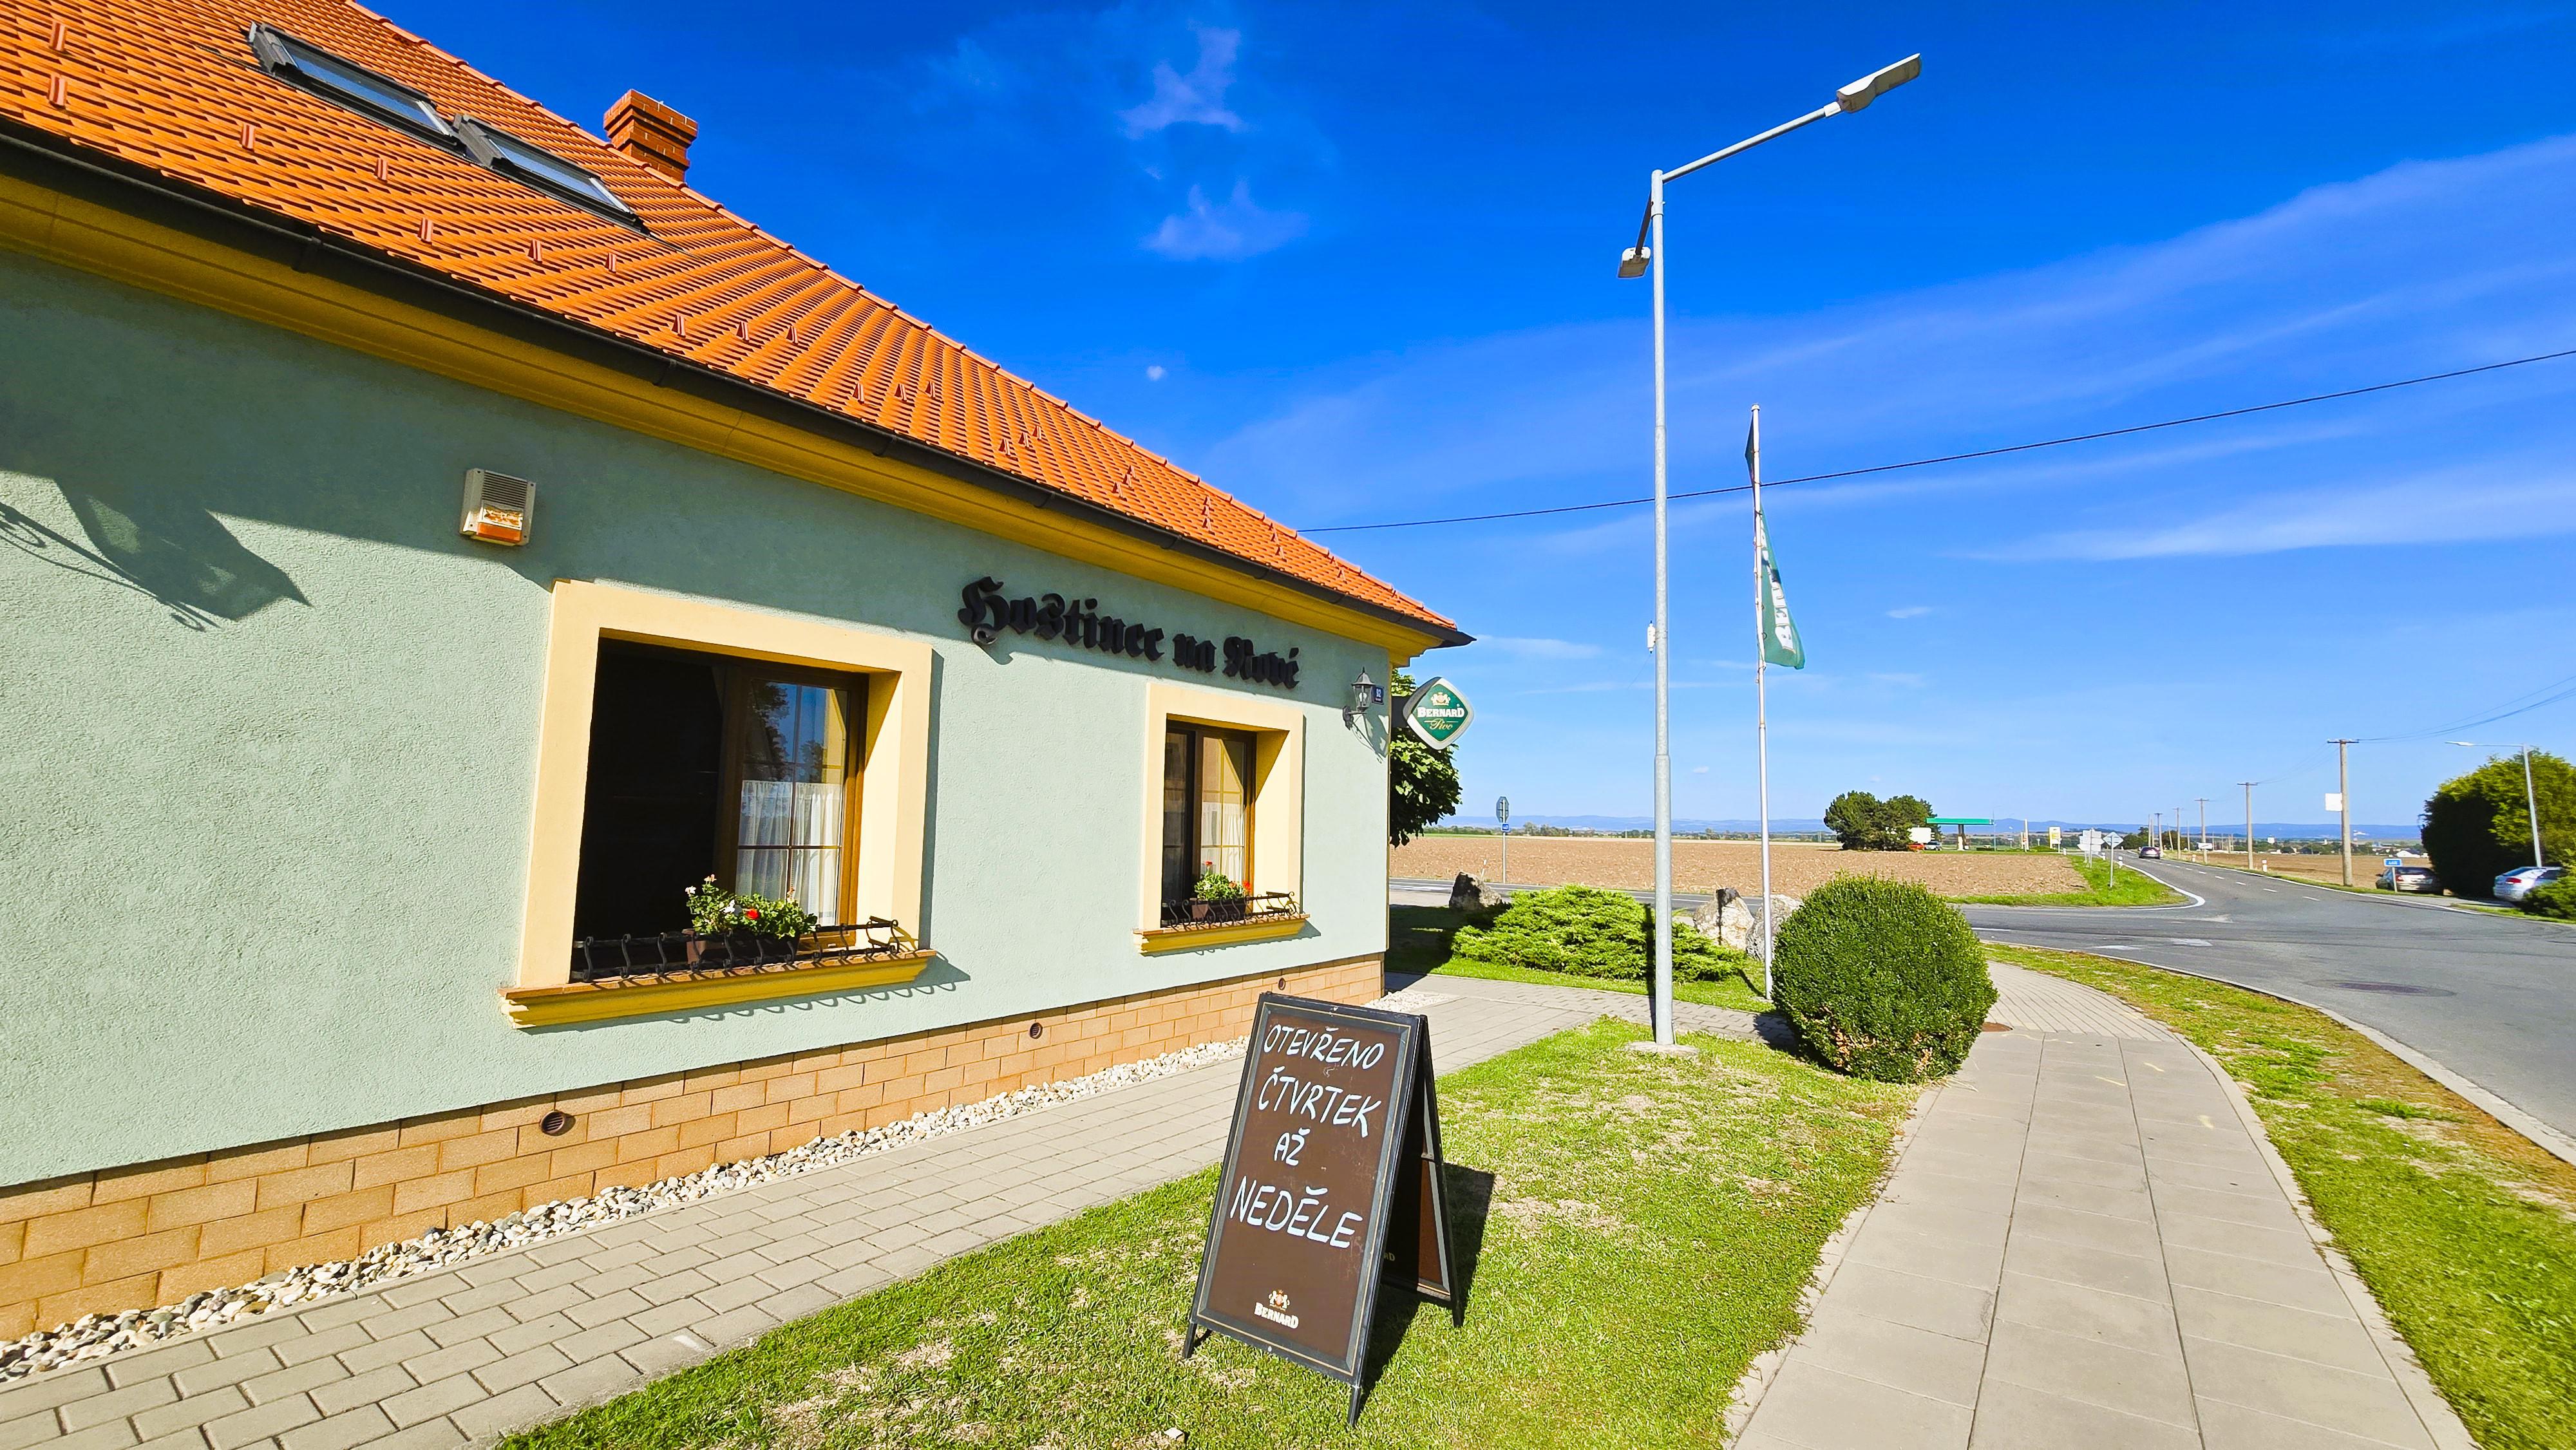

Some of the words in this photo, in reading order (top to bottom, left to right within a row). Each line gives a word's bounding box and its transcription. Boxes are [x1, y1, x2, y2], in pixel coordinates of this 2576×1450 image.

[958, 576, 1165, 661] Hostinec
[1172, 633, 1217, 673] na
[1417, 705, 1464, 718] BERNARD
[1264, 1024, 1385, 1069] OTEVŘENO
[1258, 1066, 1382, 1138] ČTVRTEK
[1274, 1127, 1311, 1166] AŽ
[1229, 1175, 1363, 1248] NEDĚLE
[1254, 1302, 1299, 1329] BERNARD
